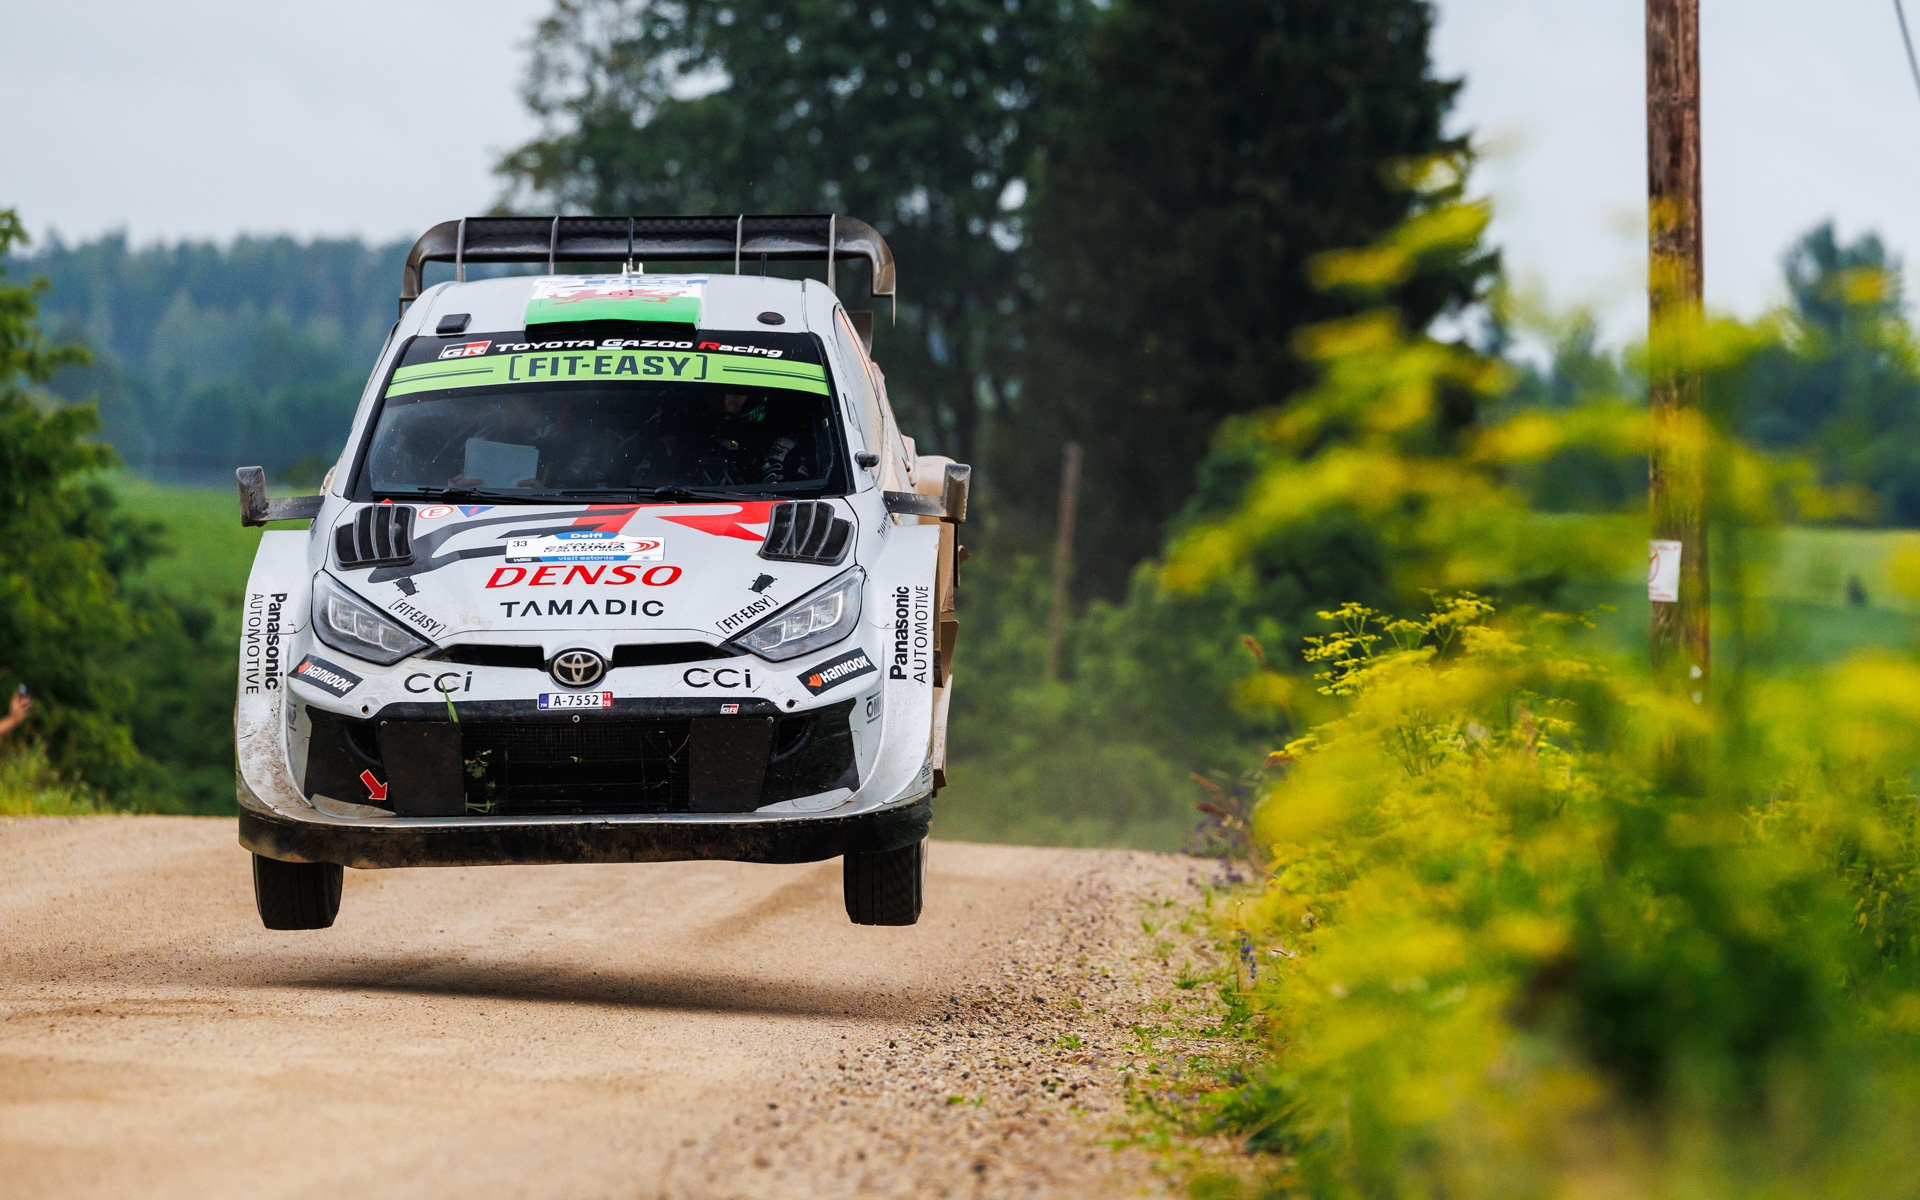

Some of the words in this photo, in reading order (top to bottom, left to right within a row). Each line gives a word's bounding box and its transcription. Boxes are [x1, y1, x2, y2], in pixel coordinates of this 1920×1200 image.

[496, 340, 595, 352] TOYOTA
[601, 338, 694, 349] GAZOO
[699, 341, 784, 358] Racing
[485, 565, 683, 589] DENSO
[500, 600, 664, 618] TAMADIC
[889, 586, 910, 680] Panasonic
[913, 585, 929, 684] AUTOMOTIVE
[246, 593, 264, 695] AUTOMOTIVE
[265, 592, 288, 690] Panasonic
[553, 694, 599, 707] A-7552
